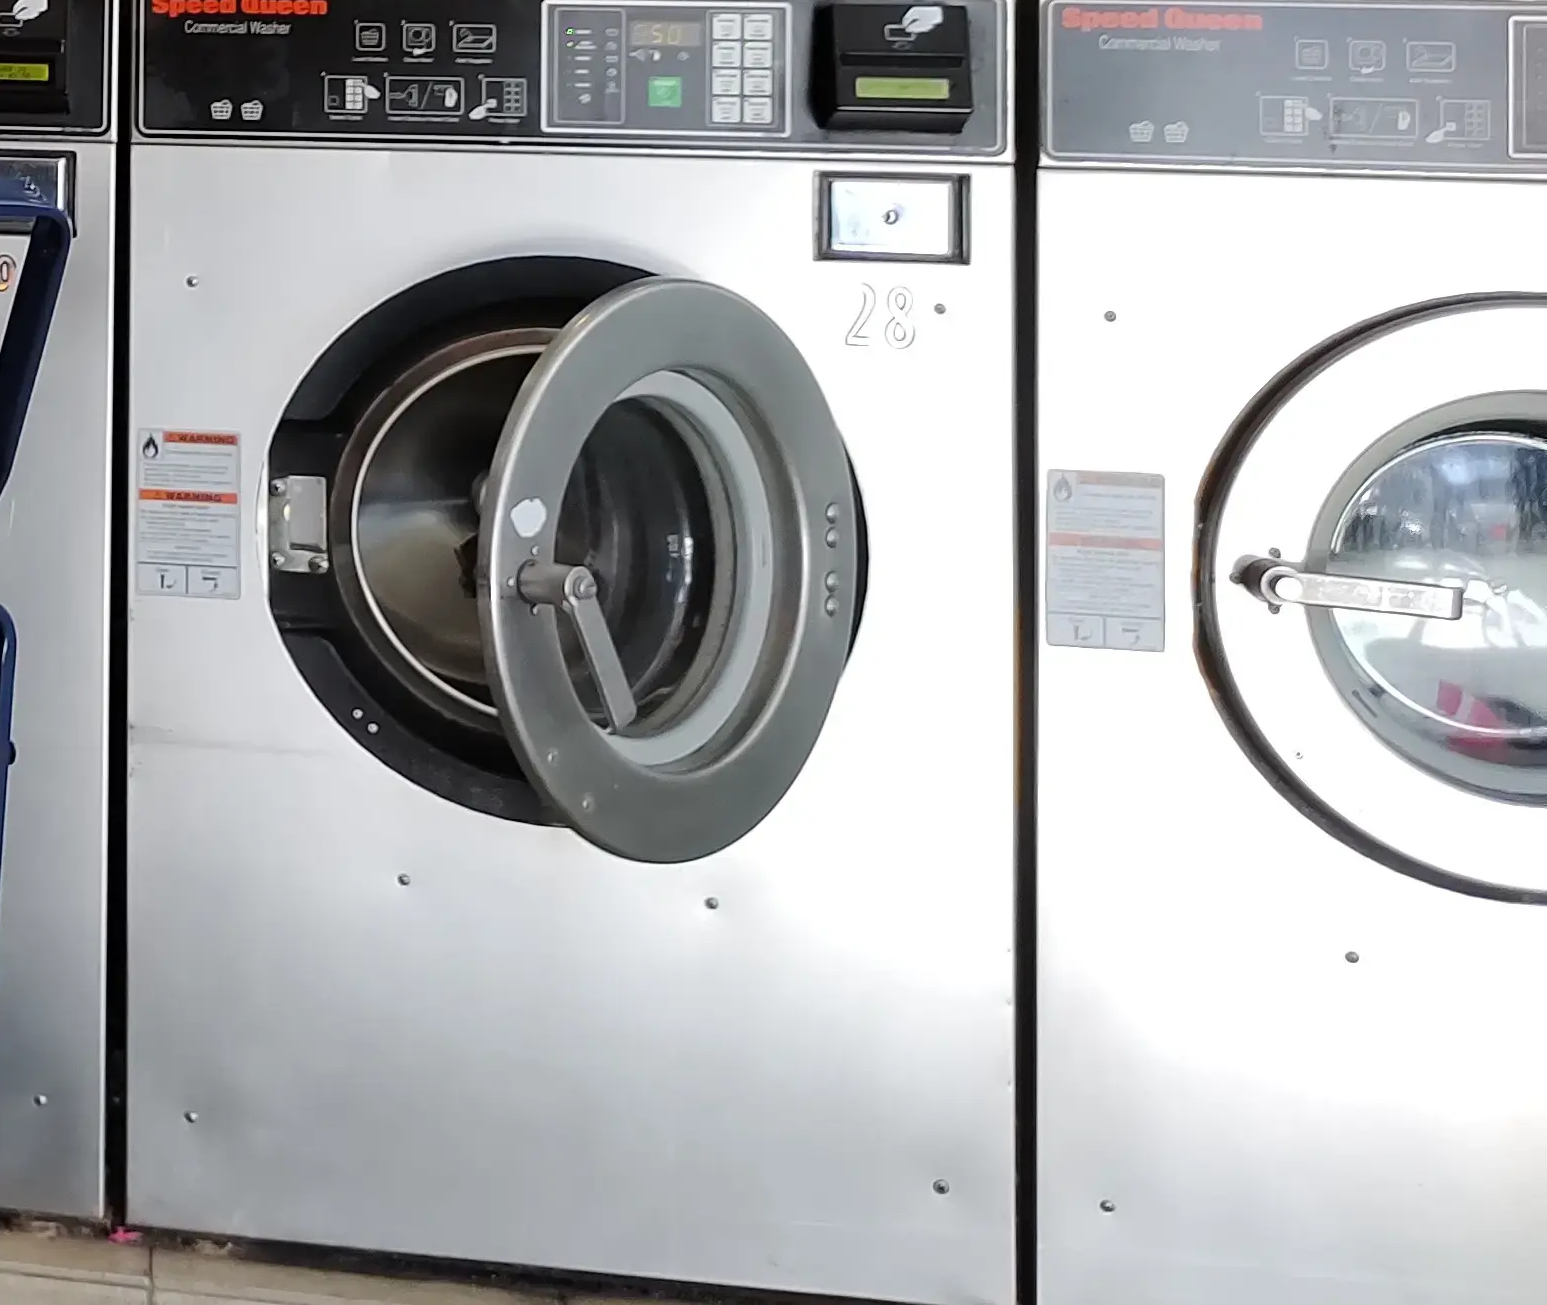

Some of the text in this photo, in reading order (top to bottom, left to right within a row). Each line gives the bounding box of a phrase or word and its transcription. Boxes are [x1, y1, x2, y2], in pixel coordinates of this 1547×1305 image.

[183, 19, 292, 36] Commercial Washer
[1060, 6, 1264, 32] Speed Queen
[1098, 35, 1222, 52] Commercial Washer
[844, 281, 917, 351] 28
[164, 491, 223, 503] WARNING
